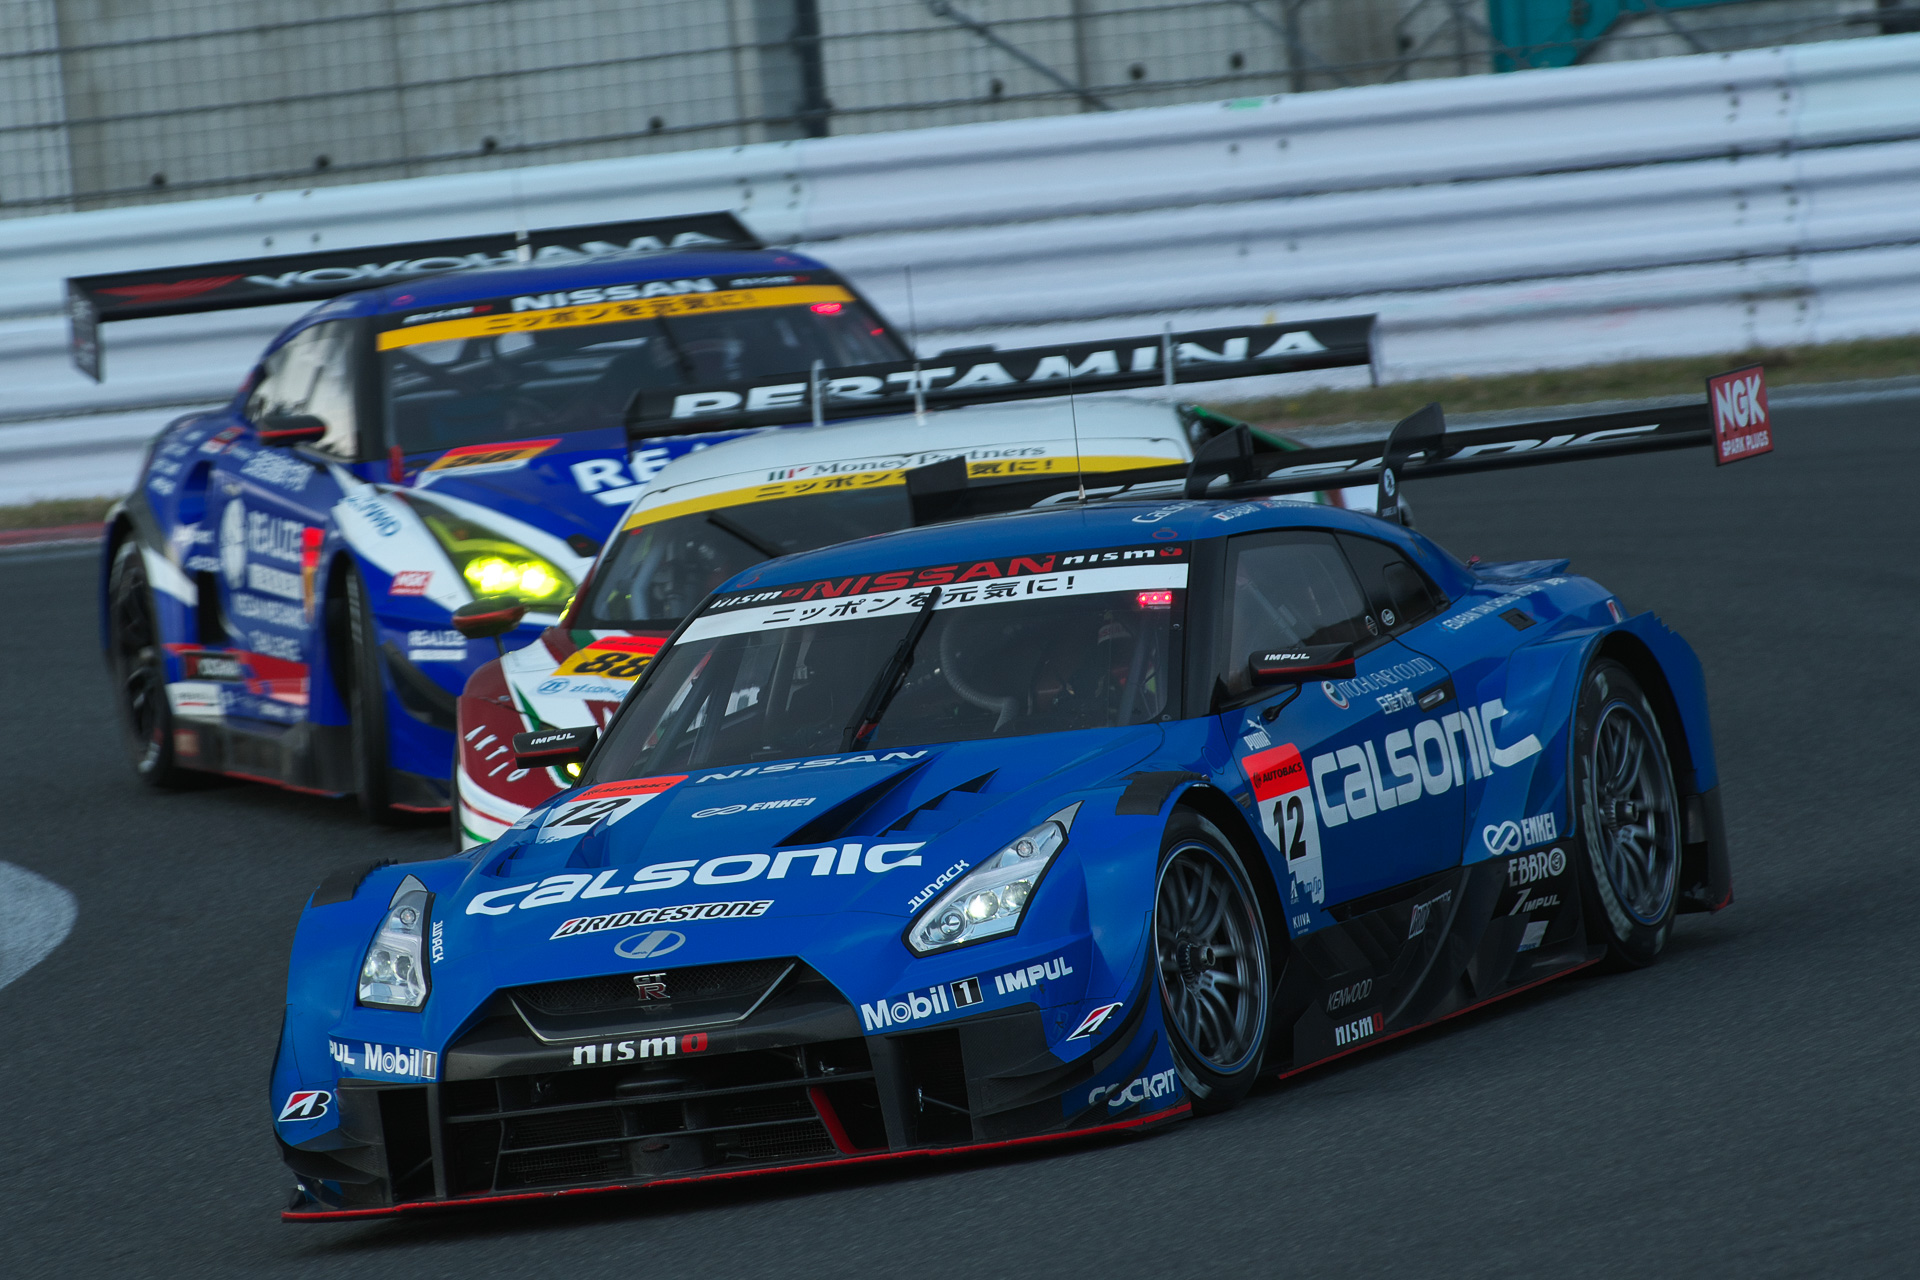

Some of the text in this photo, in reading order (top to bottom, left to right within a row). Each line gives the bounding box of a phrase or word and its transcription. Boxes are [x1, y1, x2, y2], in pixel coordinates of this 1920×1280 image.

[511, 277, 718, 312] NISSAN
[672, 330, 1329, 418] PERTAMINA
[1715, 374, 1765, 433] NGK
[813, 456, 911, 477] Money
[1062, 547, 1182, 566] nismo
[801, 555, 1056, 600] NISSAN
[709, 587, 803, 609] nismo
[573, 652, 654, 677] 88
[1264, 652, 1310, 661] IMPUL
[530, 732, 576, 745] IMPUL
[696, 750, 928, 784] NISSAN
[1262, 762, 1303, 783] AUTOBACS
[543, 798, 632, 828] 12
[747, 797, 817, 812] ENKEI
[1273, 795, 1307, 861] 12
[1520, 812, 1557, 847] ENKEI
[908, 859, 970, 914] JUNACK
[1522, 894, 1561, 913] IMPUL
[551, 900, 773, 939] BRIDGESTONE
[633, 973, 667, 984] GT
[636, 983, 671, 1001] R
[994, 957, 1074, 994] IMPUL
[860, 984, 950, 1032] Mobil
[1326, 978, 1373, 1013] KENWOOD
[1335, 1012, 1384, 1047] nismo
[364, 1043, 420, 1077] Mobil
[572, 1033, 708, 1066] nismo
[1089, 1068, 1176, 1108] COCKPIT
